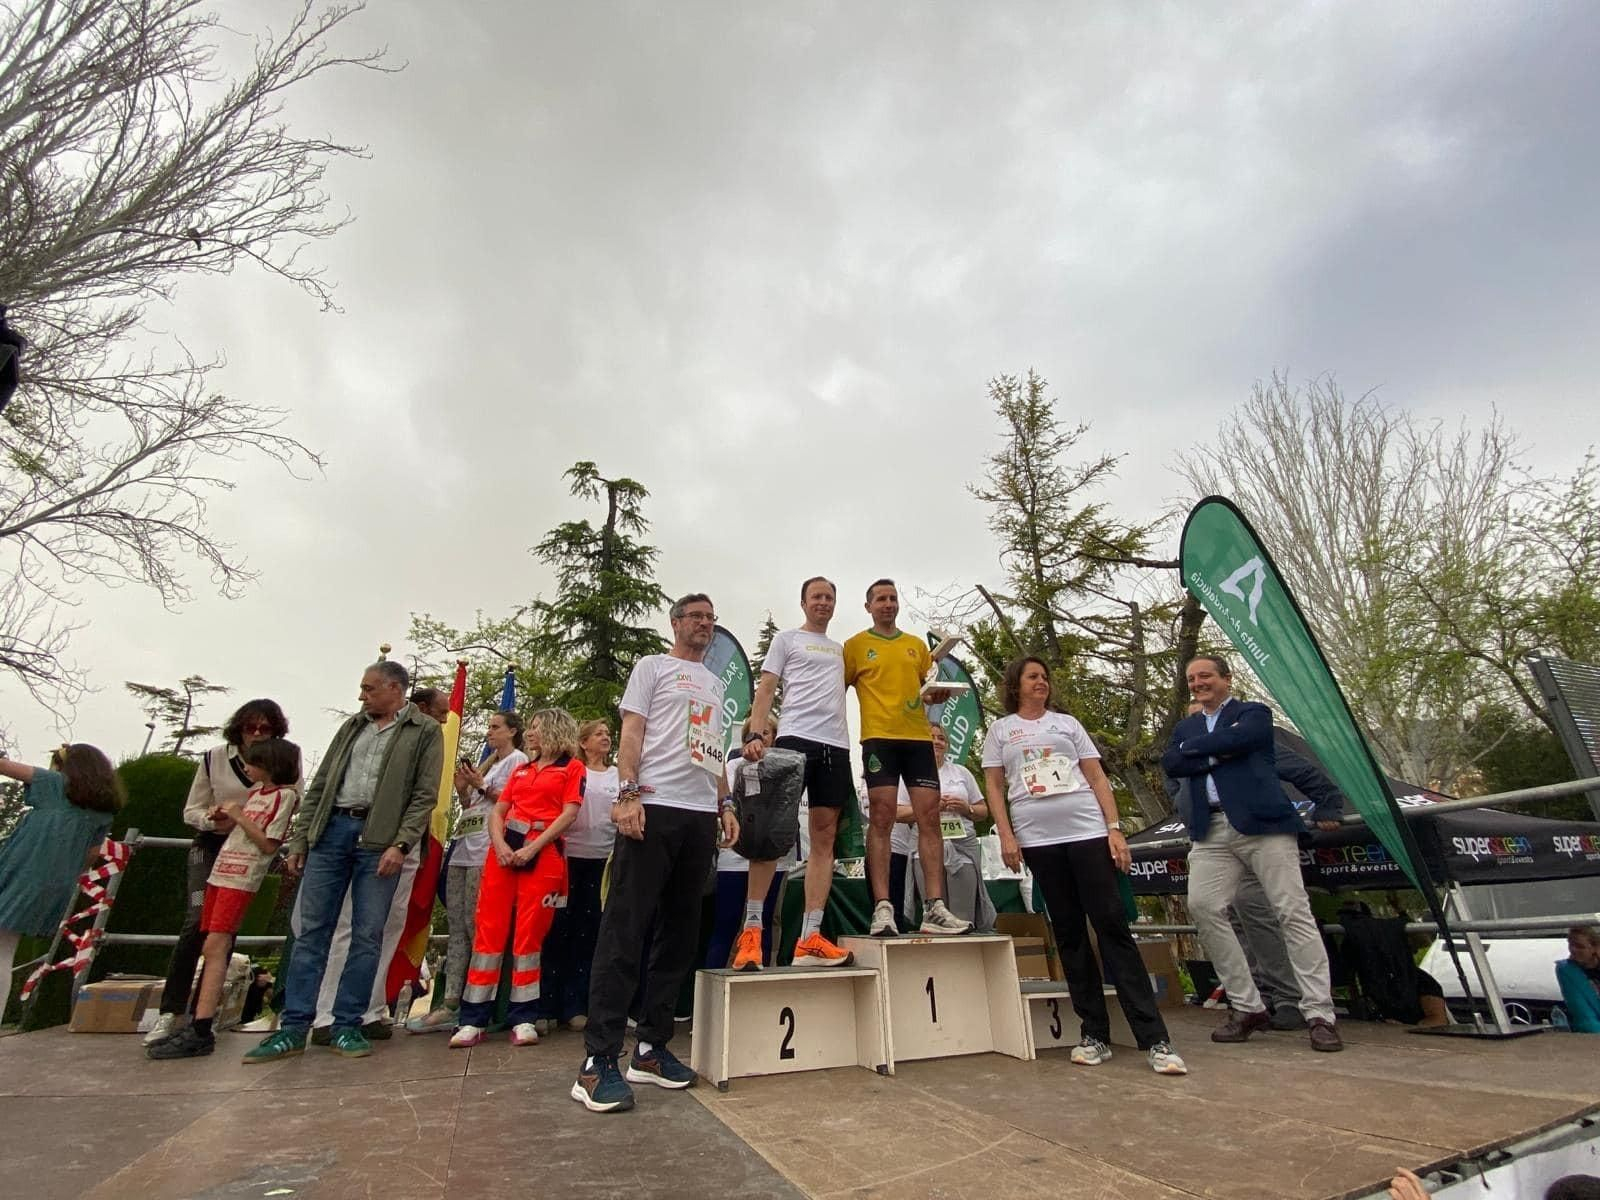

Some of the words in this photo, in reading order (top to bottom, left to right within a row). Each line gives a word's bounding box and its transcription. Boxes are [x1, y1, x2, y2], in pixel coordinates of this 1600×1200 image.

[700, 742, 723, 763] 1448
[1052, 770, 1061, 781] 1
[1320, 863, 1400, 876] sport&events
[925, 975, 938, 1024] 1
[779, 1006, 796, 1060] 2
[1046, 998, 1062, 1040] 3
